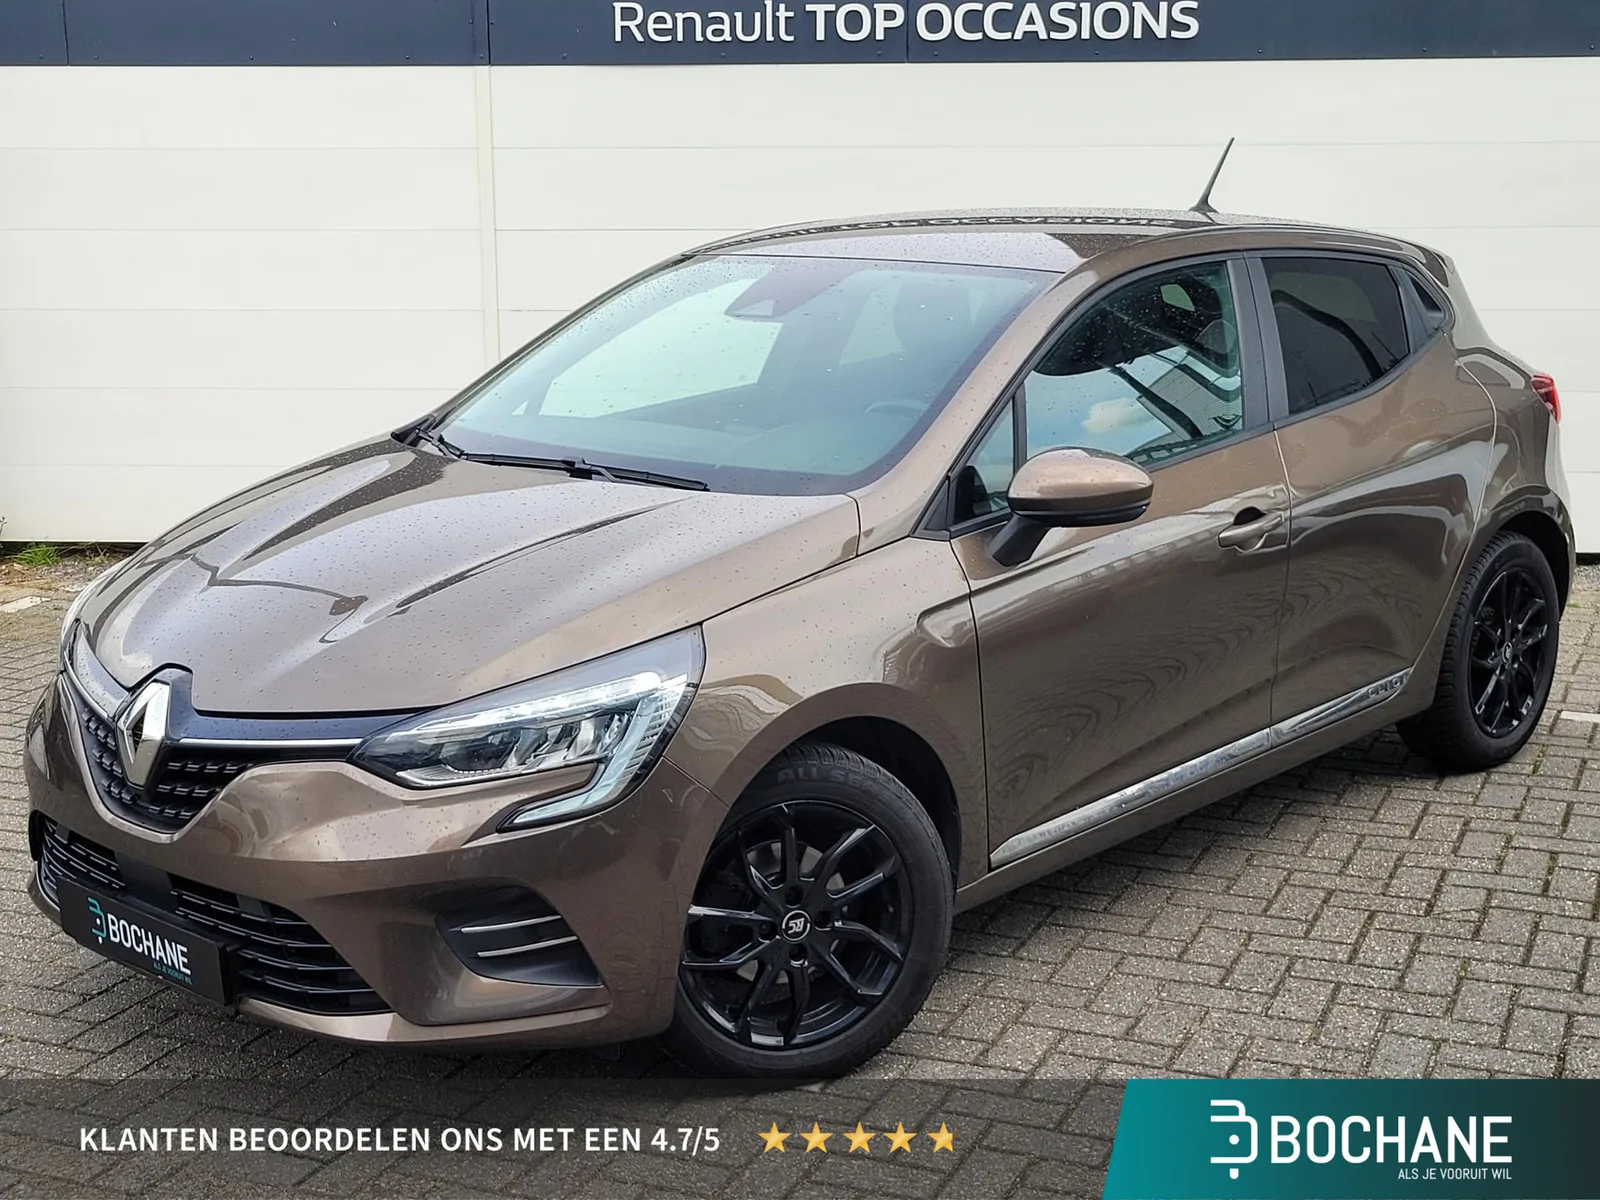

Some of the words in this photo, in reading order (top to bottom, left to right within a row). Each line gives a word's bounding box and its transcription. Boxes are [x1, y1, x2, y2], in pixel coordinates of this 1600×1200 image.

[612, 0, 795, 42] Renault
[805, 3, 905, 41] TOP
[916, 0, 1199, 41] OCCASIONS
[107, 913, 192, 976] BOCHANE
